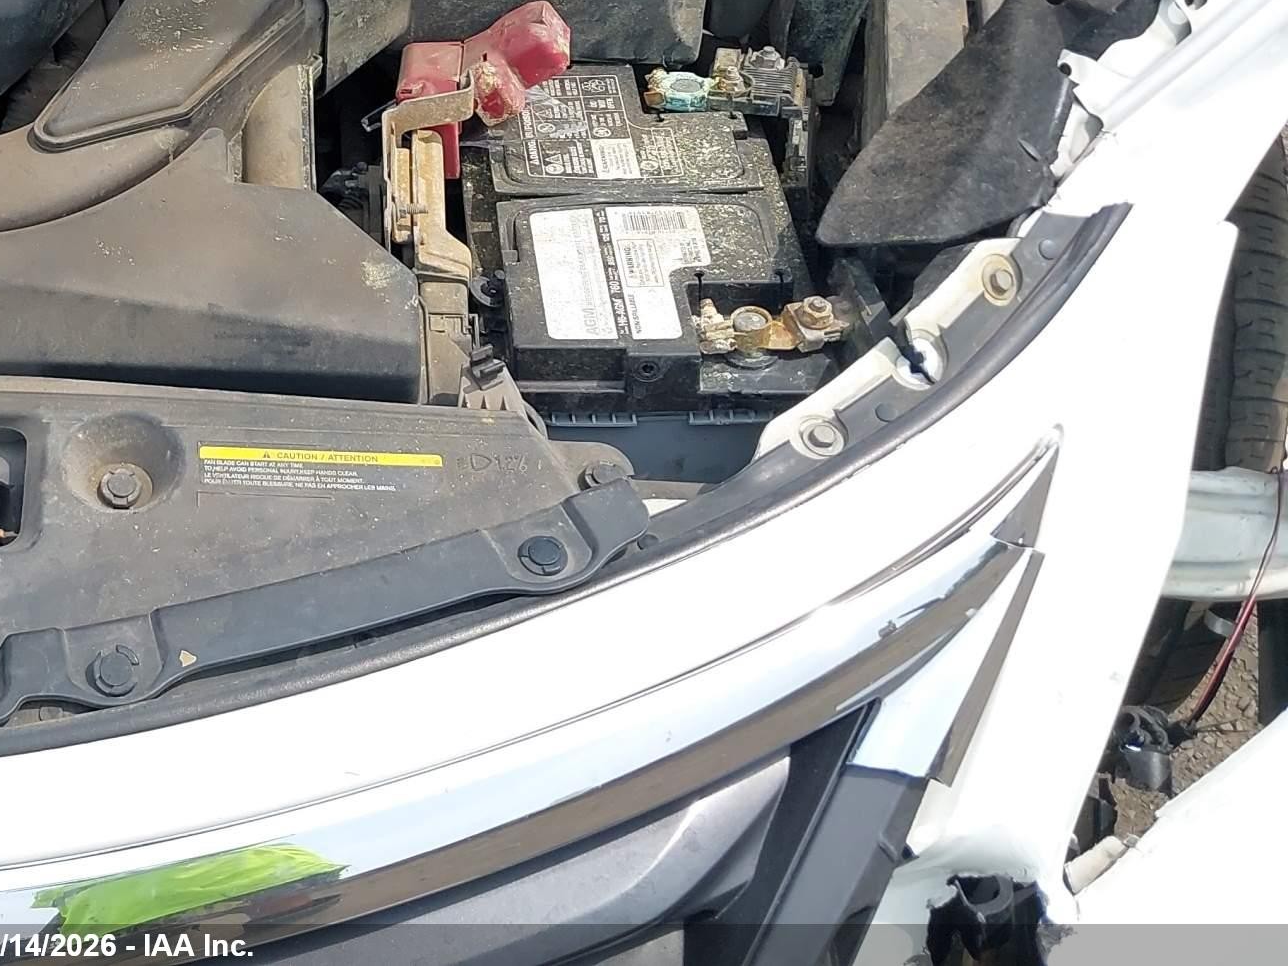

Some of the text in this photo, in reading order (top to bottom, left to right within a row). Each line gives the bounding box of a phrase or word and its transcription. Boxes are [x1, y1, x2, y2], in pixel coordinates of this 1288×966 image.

[582, 308, 598, 334] AGM
[277, 452, 317, 460] CAUTION
[328, 454, 378, 462] ATTENTION
